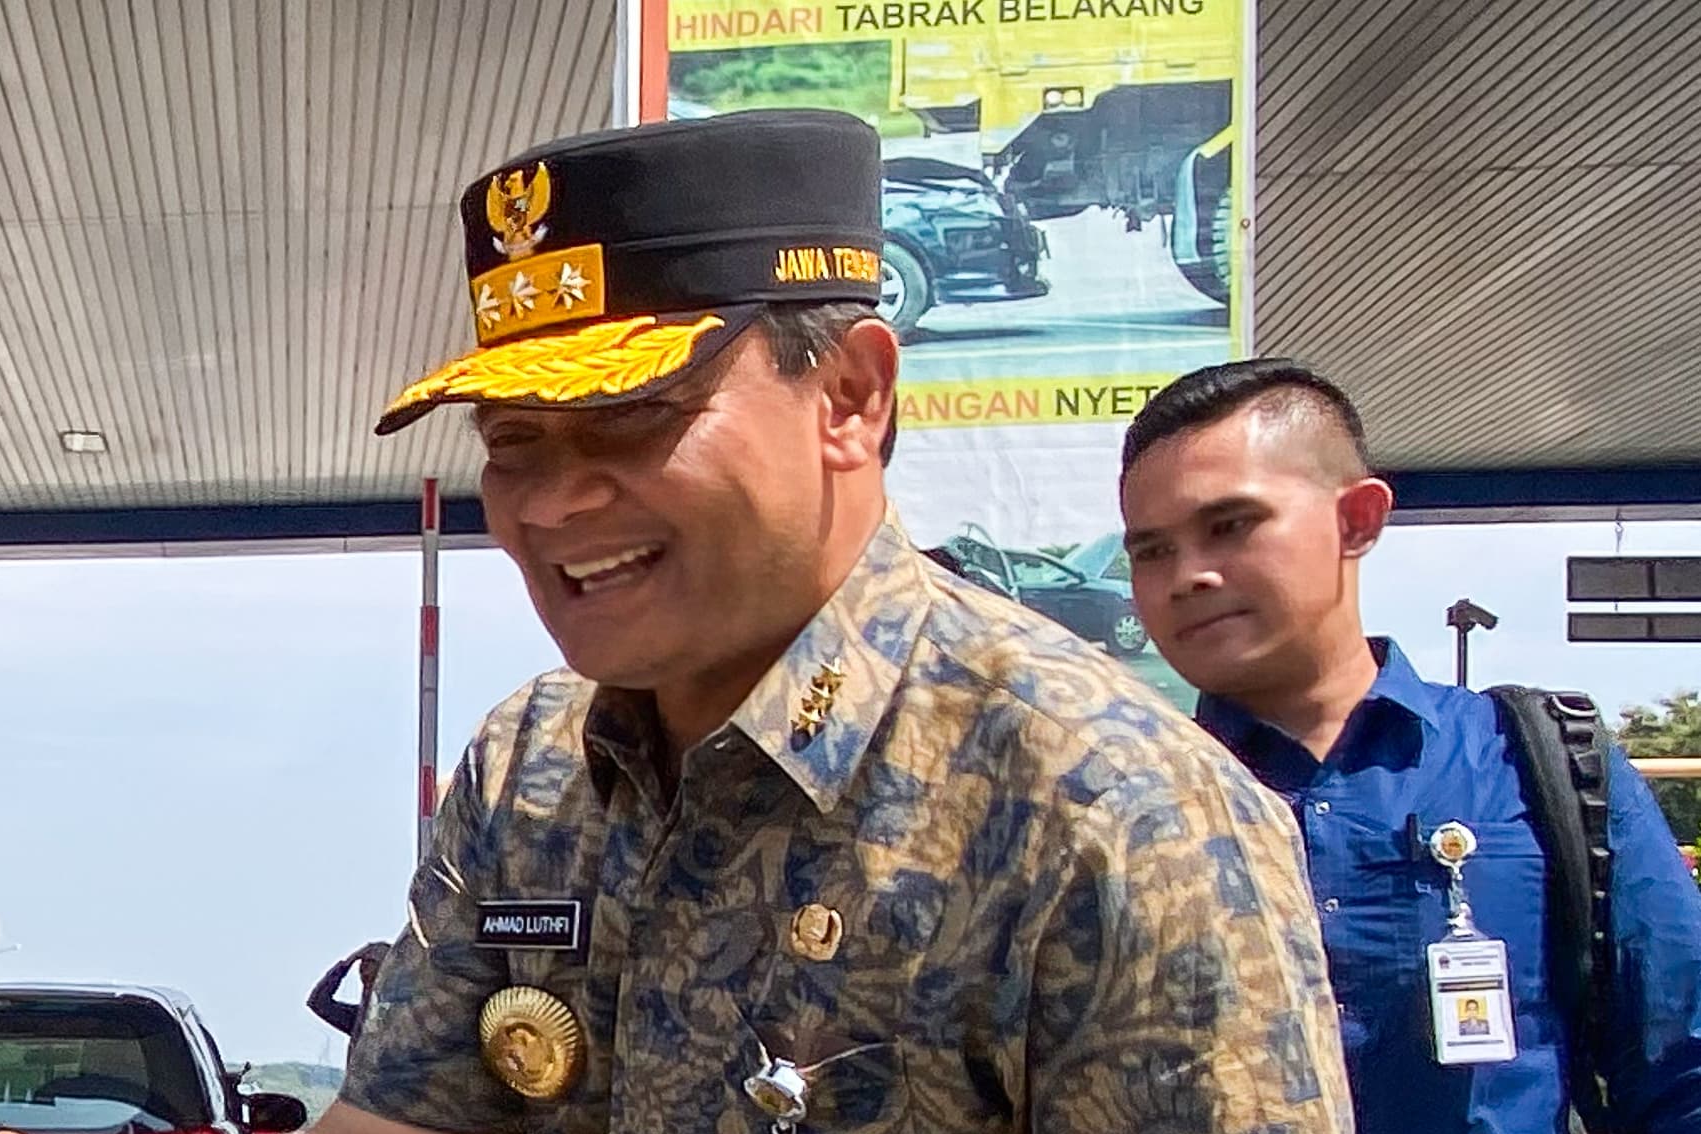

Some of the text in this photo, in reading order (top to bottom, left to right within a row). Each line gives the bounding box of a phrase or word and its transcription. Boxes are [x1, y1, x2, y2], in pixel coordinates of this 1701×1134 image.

[675, 0, 1205, 40] HINDARI TABRAK BELAKANG
[775, 247, 829, 282] JAWA
[898, 386, 1160, 422] ANGAN NYET
[483, 915, 570, 934] AHMAD LUTHFI
